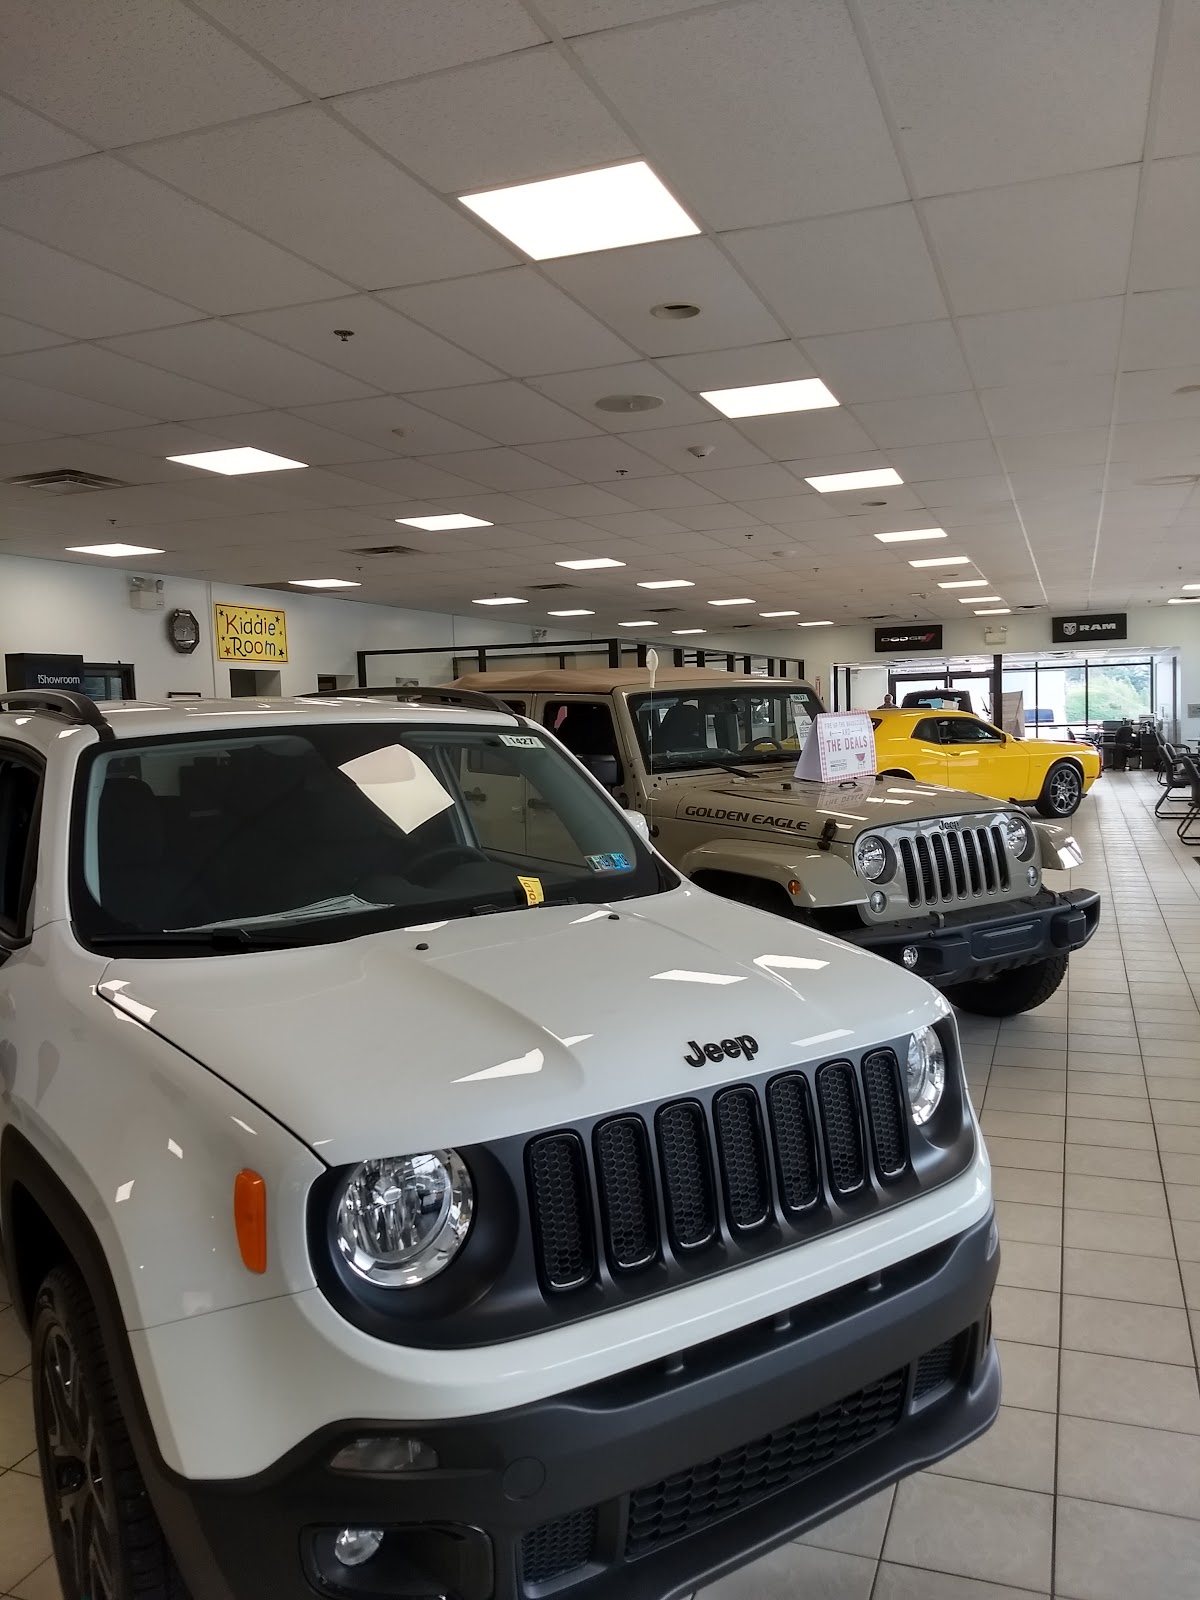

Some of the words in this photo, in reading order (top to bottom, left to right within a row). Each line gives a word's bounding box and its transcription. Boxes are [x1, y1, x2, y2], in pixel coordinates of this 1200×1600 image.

[225, 613, 276, 636] Kiddie
[1079, 622, 1117, 631] RAM
[229, 636, 276, 657] Room
[37, 673, 81, 685] iShowroom
[509, 737, 534, 746] 1427
[826, 738, 841, 753] THE
[844, 735, 868, 751] DEALS
[685, 805, 750, 823] GOLDEN
[751, 814, 810, 831] EAGLE
[939, 820, 960, 831] Jeep
[683, 1034, 759, 1068] Jeep
